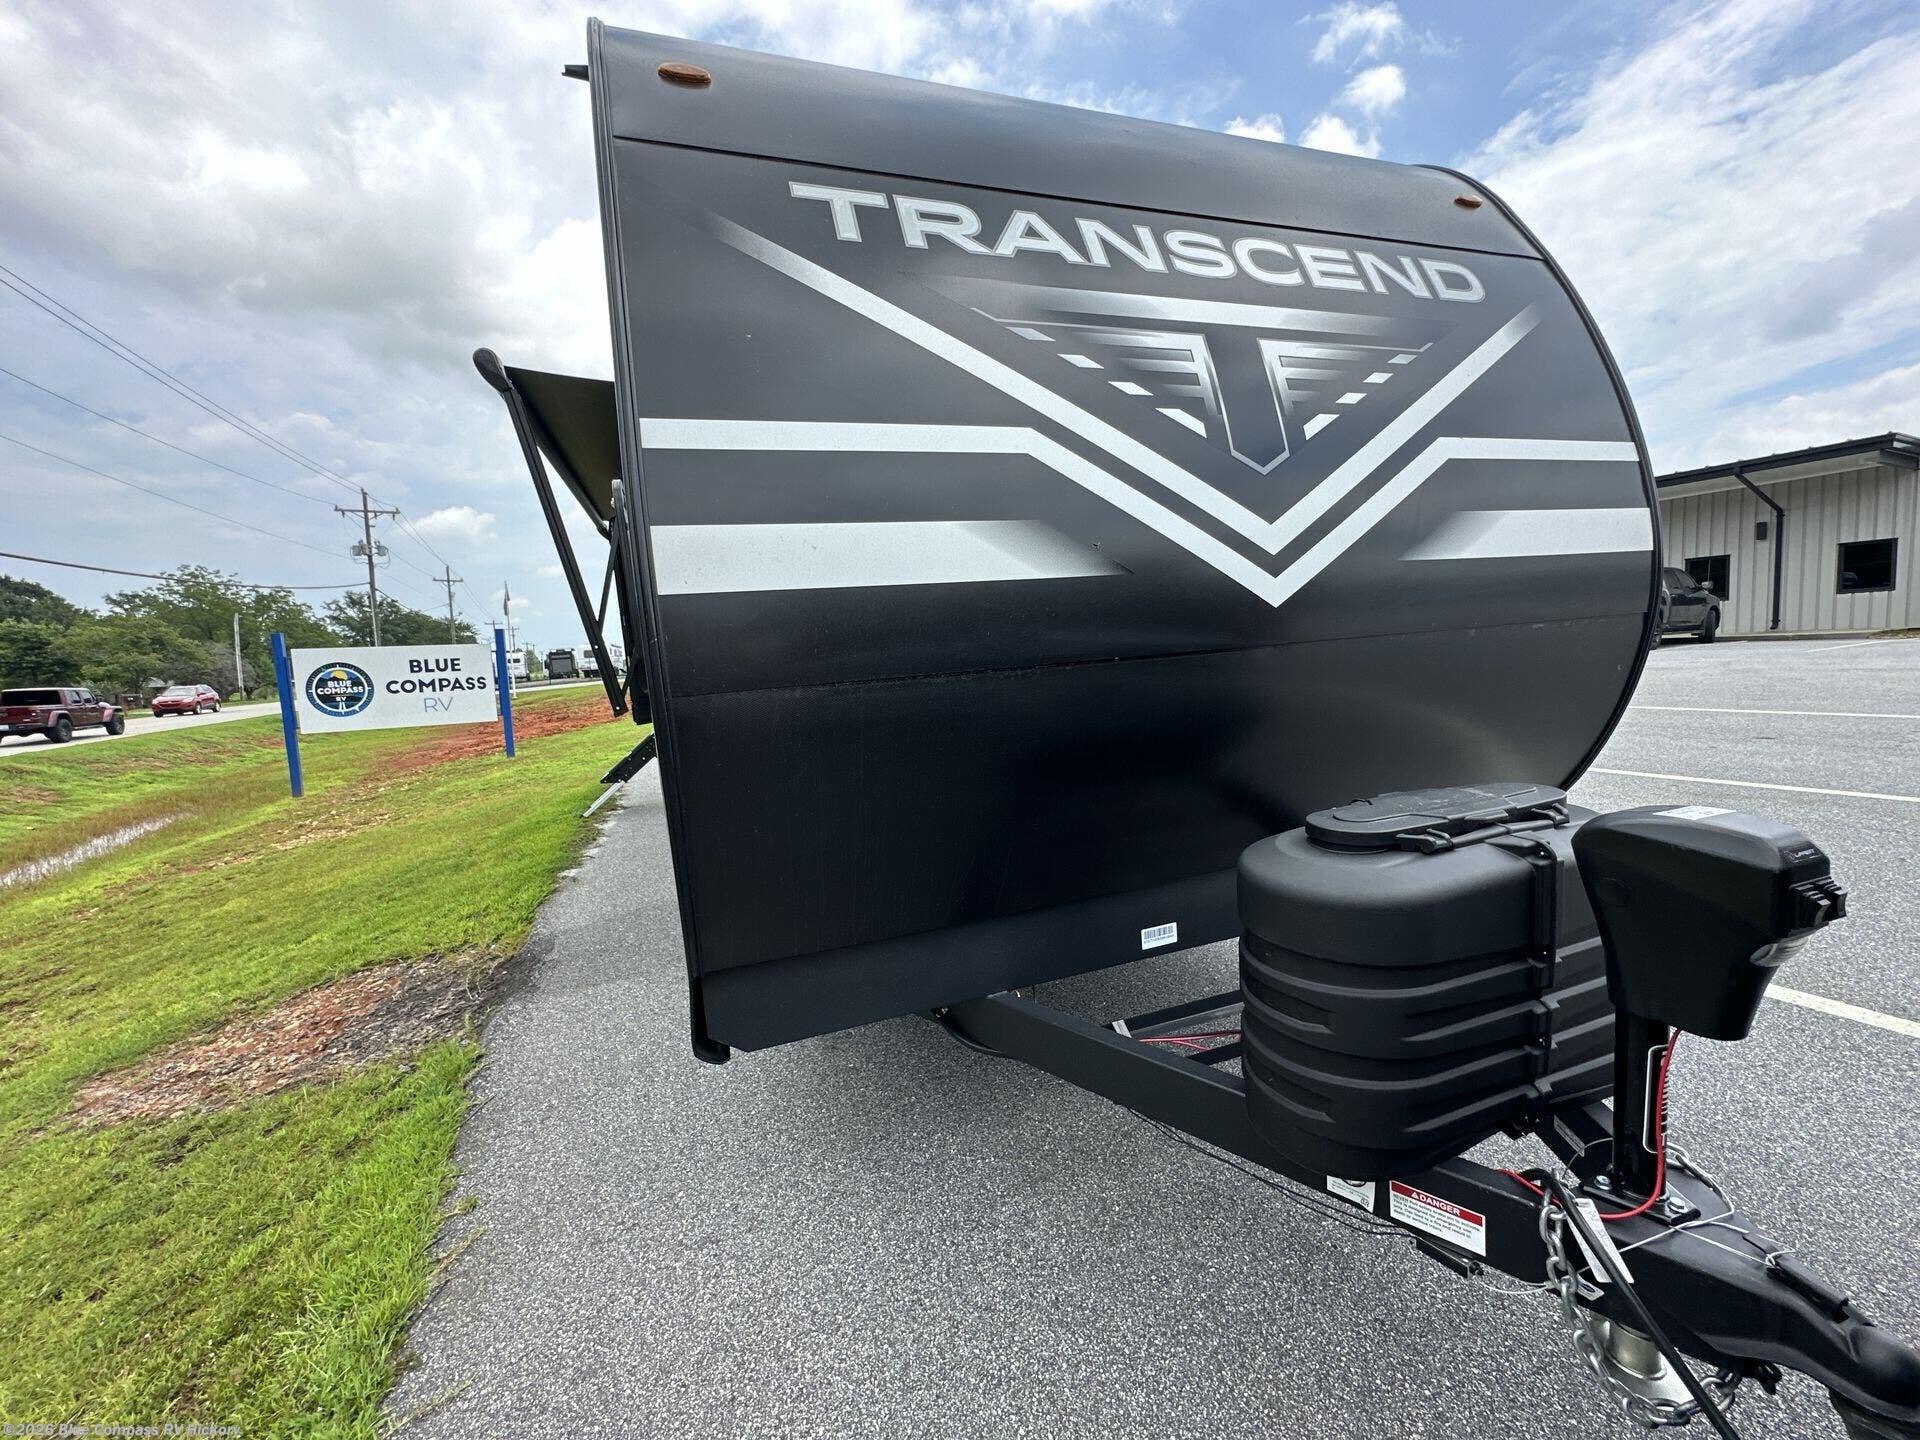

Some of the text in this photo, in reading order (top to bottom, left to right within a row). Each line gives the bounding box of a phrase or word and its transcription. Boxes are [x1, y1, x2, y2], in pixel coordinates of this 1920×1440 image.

[789, 181, 1486, 303] TRANSCEND
[409, 658, 461, 673] BLUE
[317, 686, 364, 695] COMPASS
[386, 676, 487, 694] COMPASS
[424, 697, 453, 712] RV
[1420, 1194, 1460, 1216] DANGER
